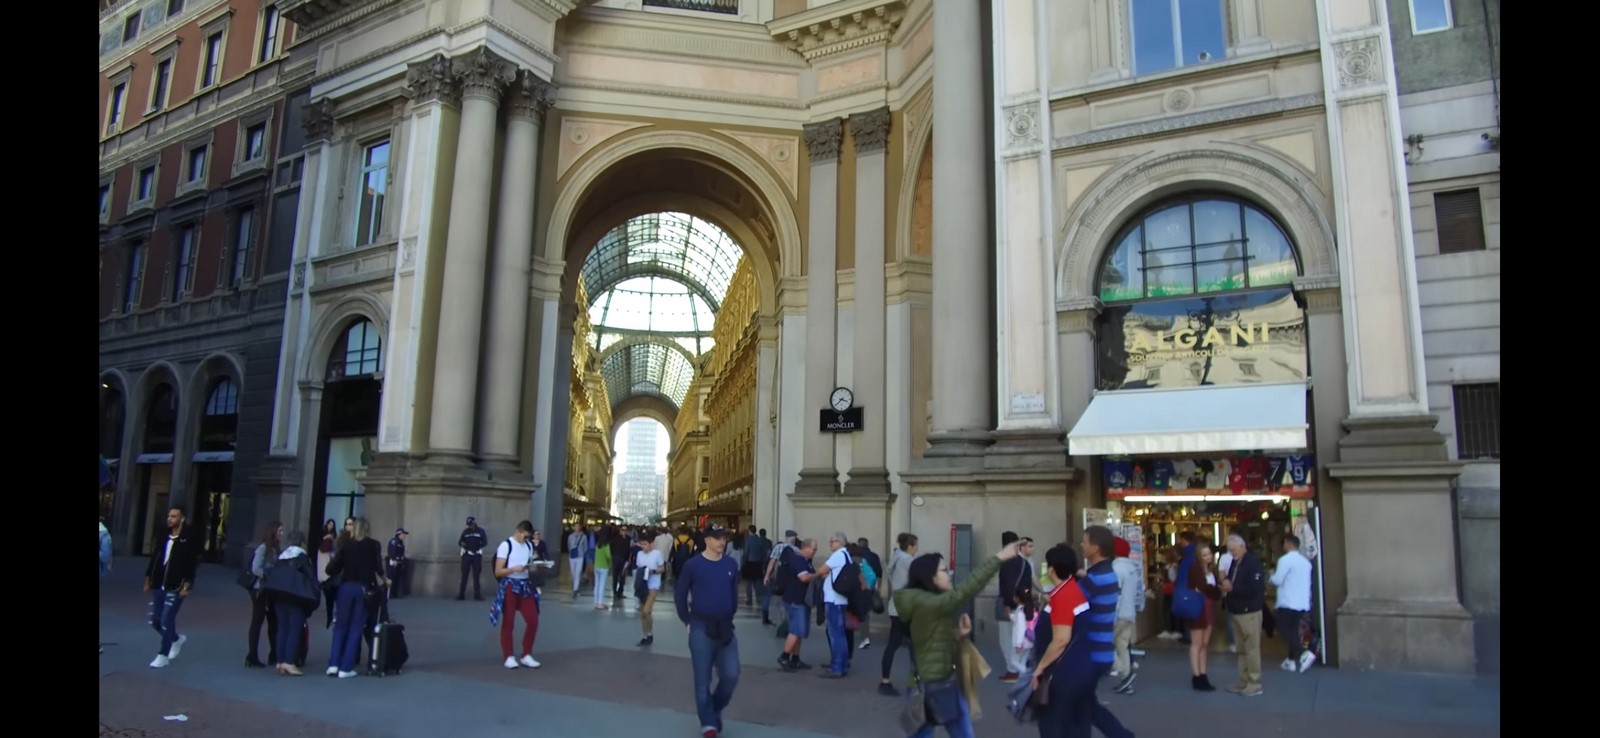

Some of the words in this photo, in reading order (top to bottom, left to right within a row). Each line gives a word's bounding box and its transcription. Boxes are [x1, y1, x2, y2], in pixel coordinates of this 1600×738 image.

[1130, 321, 1270, 352] ALGANI
[1270, 464, 1280, 481] 7
[1294, 466, 1304, 481] 9
